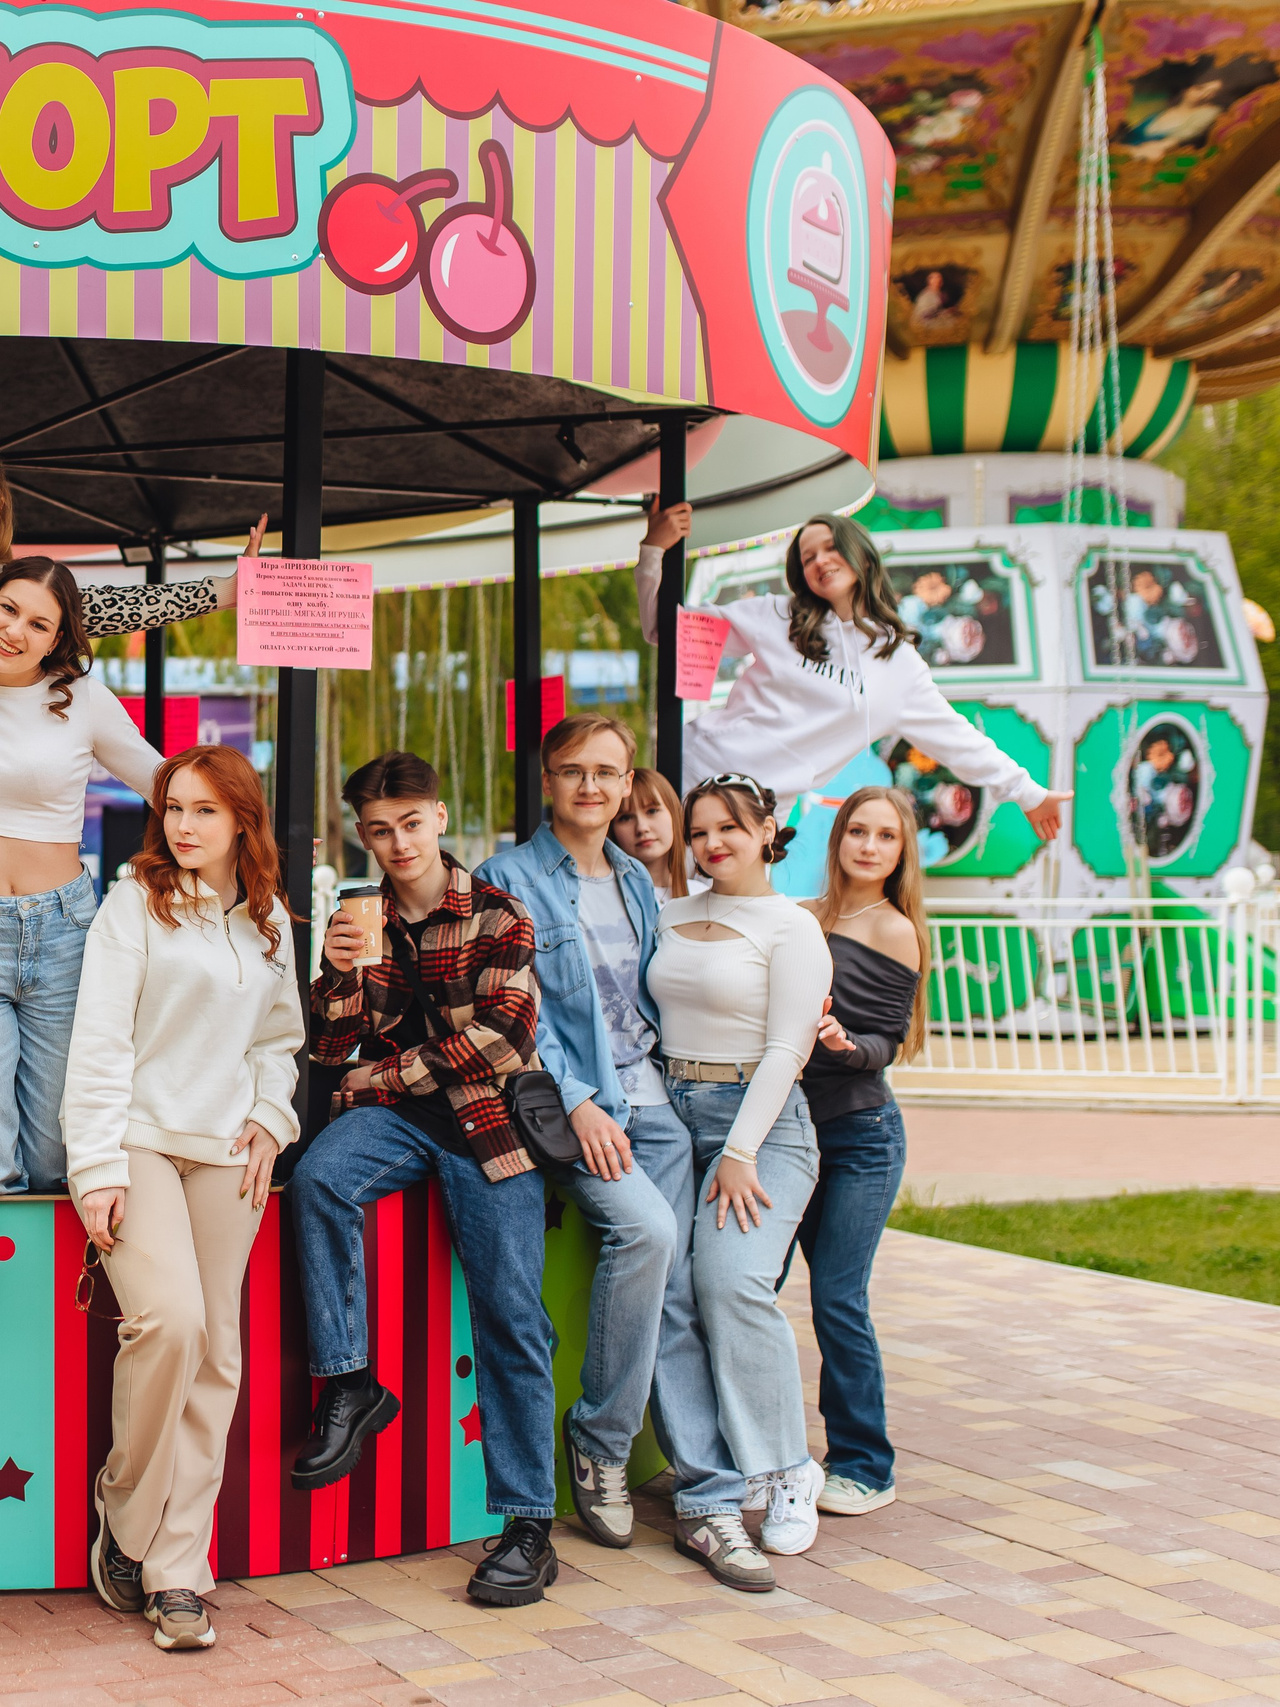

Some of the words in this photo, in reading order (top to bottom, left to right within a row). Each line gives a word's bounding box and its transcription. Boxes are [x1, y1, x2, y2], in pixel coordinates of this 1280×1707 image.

[260, 562, 279, 571] Игра
[280, 562, 329, 571] «ПРИЗОВОЙ
[250, 588, 254, 596] 5
[307, 601, 329, 610] колбу.
[249, 608, 292, 616] ВЫИГРЫШ:
[294, 610, 327, 618] МЯГКАЯ
[328, 611, 366, 619] ИГРУШКА
